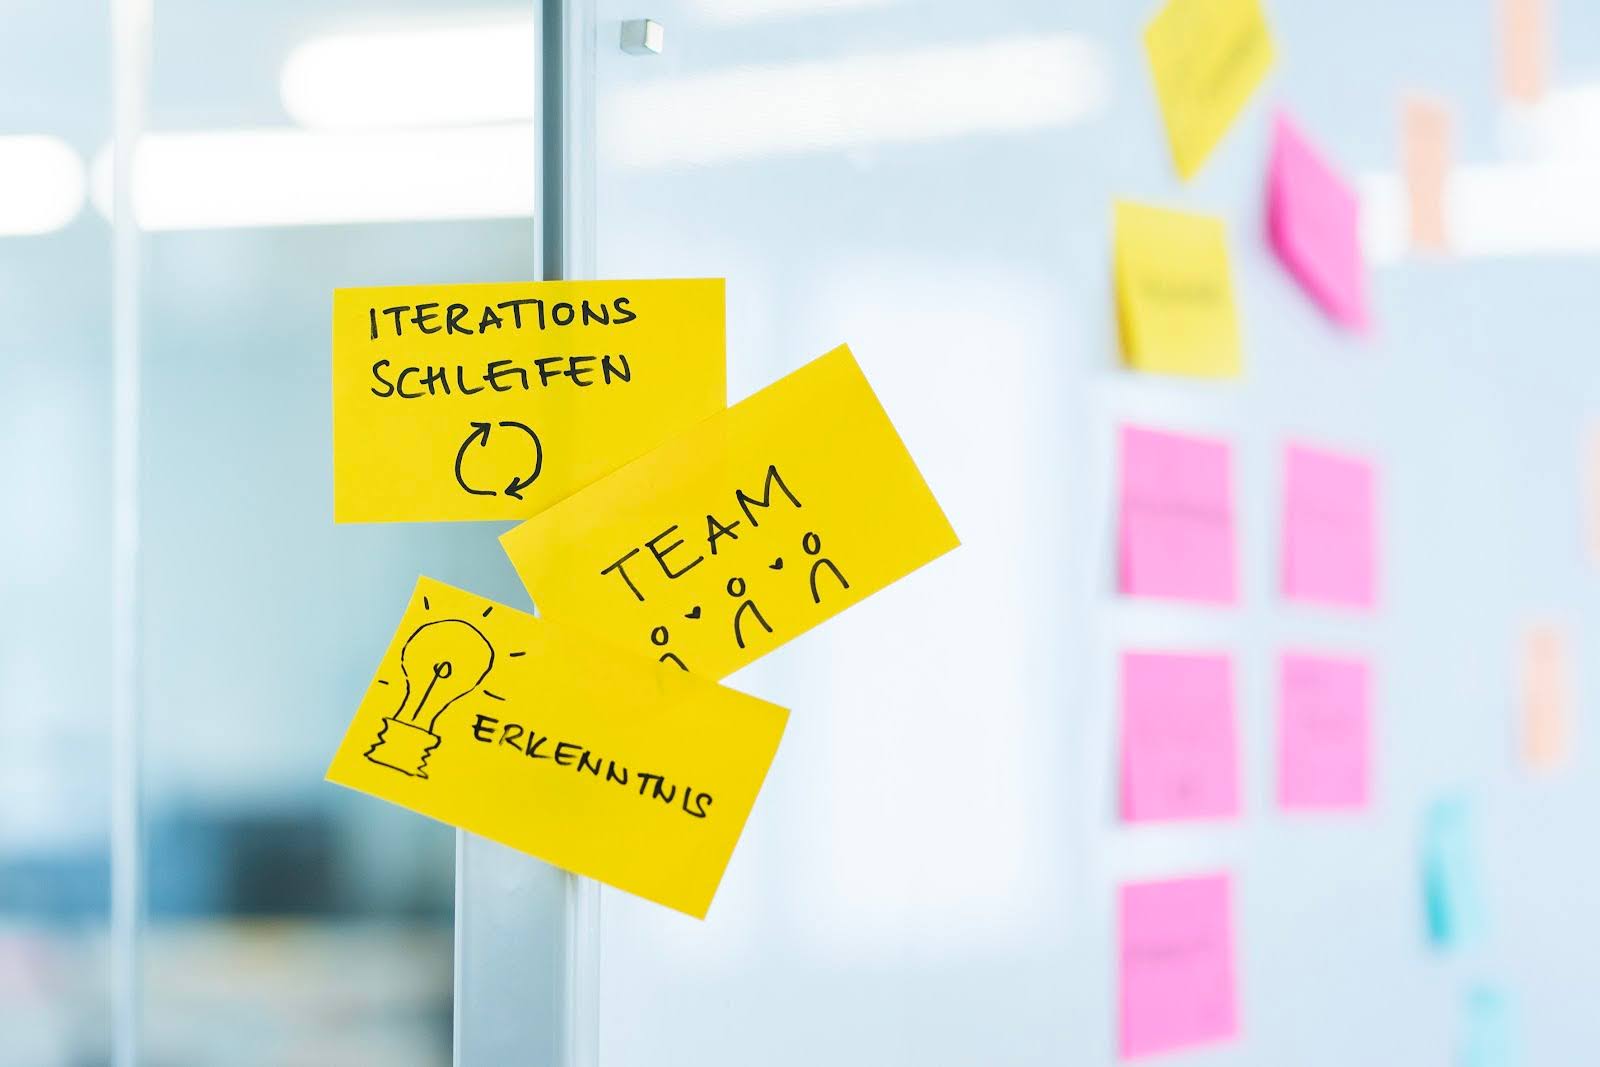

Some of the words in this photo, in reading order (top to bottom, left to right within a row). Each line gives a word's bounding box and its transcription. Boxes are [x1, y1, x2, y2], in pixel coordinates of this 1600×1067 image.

[369, 298, 637, 340] ITERATIONS
[371, 354, 631, 398] SCHLEIFEN
[600, 465, 802, 601] TEAM
[472, 714, 713, 818] ERKENNTNIS
